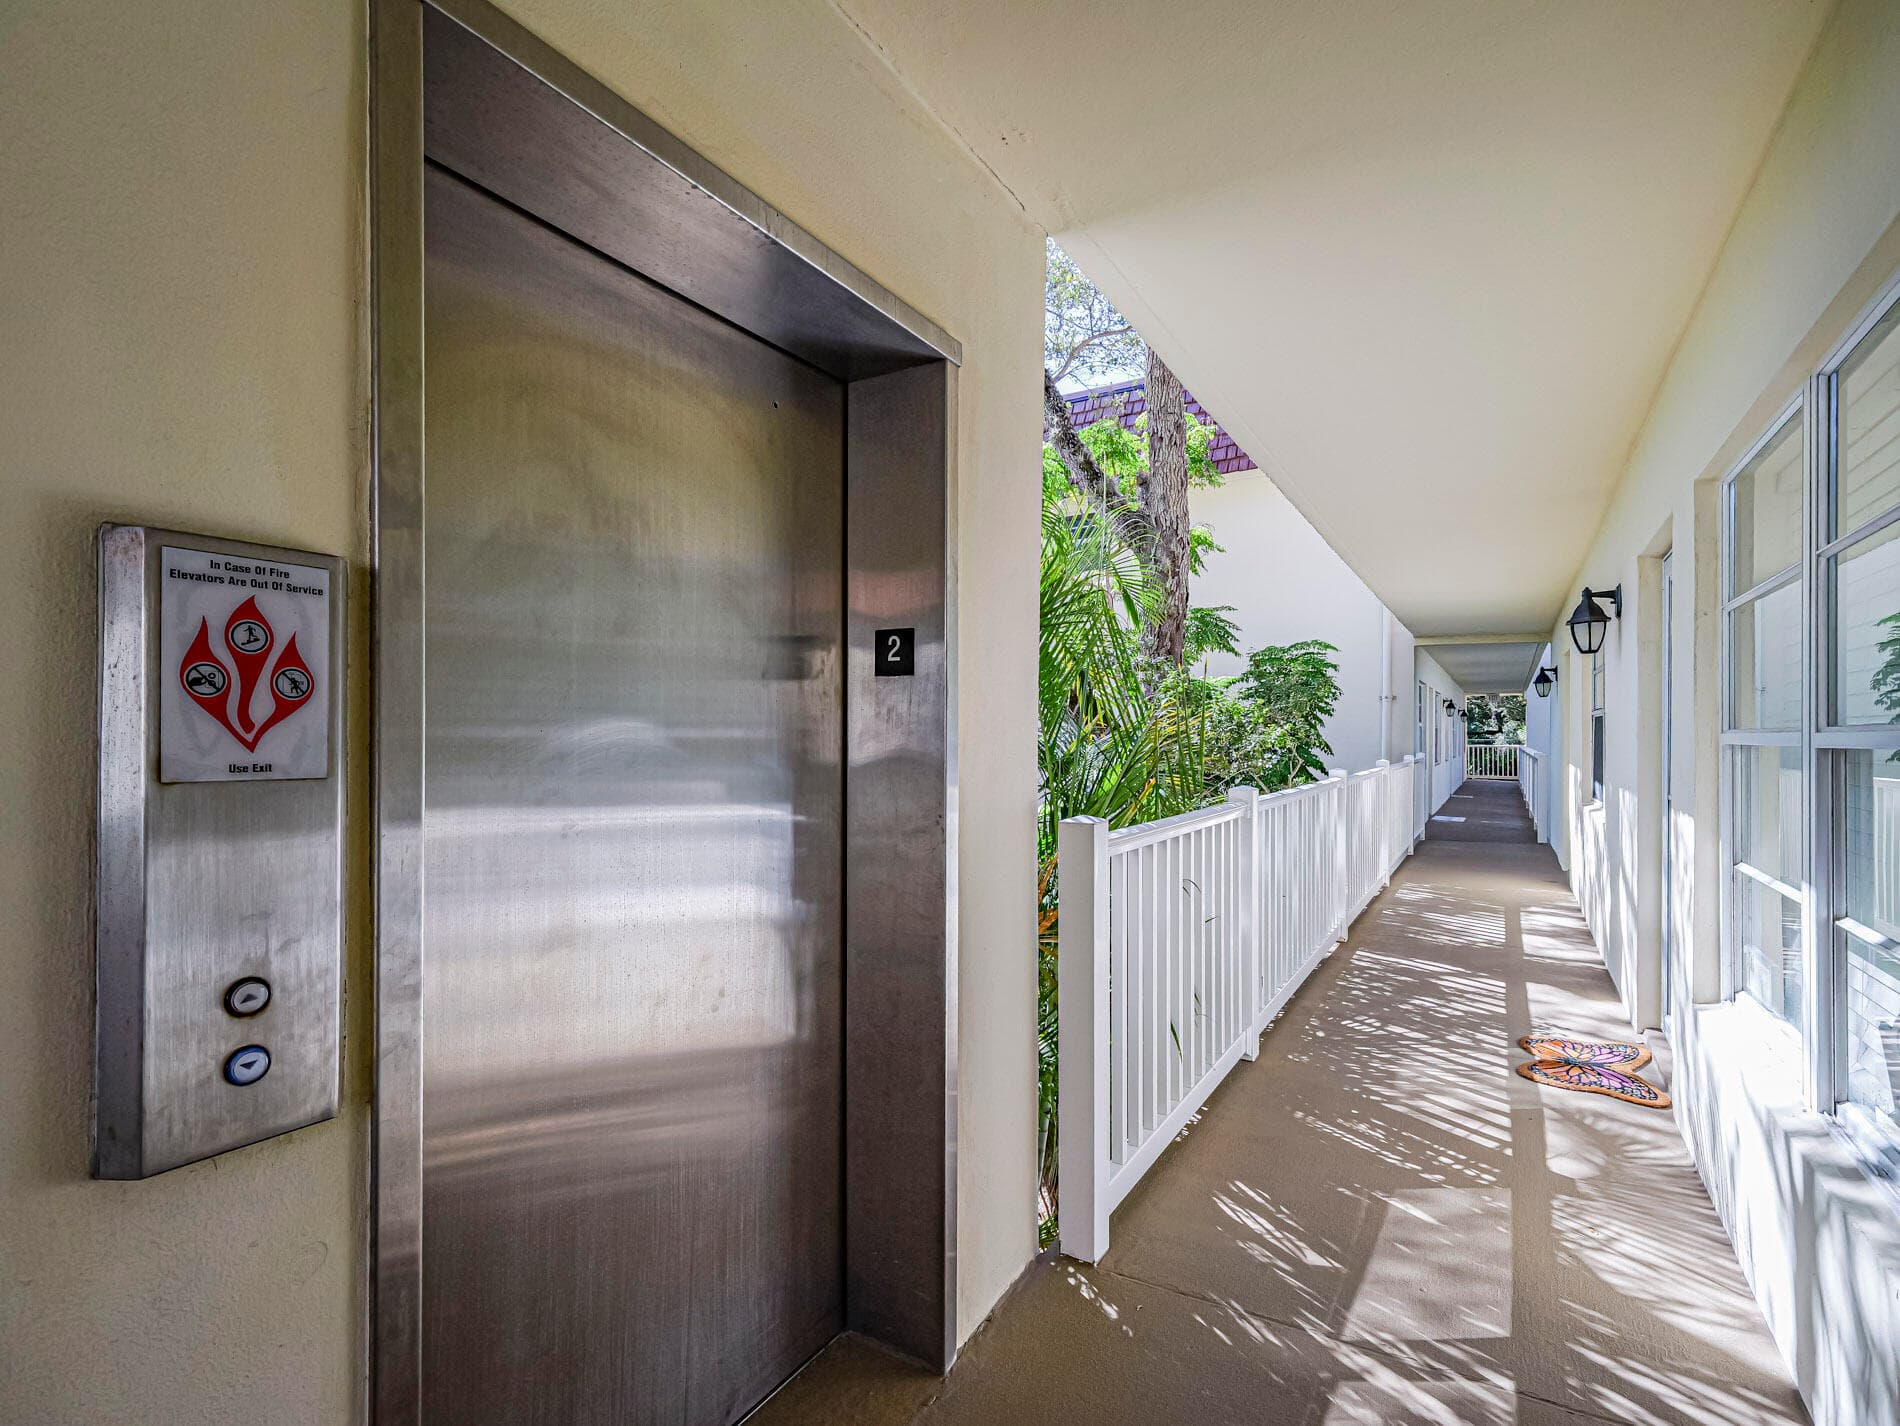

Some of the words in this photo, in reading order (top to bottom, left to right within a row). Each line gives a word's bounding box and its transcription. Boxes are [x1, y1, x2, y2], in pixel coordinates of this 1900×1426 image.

[210, 559, 221, 570] In
[224, 561, 251, 574] Case
[254, 566, 266, 576] Of
[269, 567, 290, 579] Fire
[169, 568, 225, 584] Elevators
[228, 576, 247, 587] Are
[250, 578, 269, 590] Out
[271, 581, 283, 591] Of
[286, 583, 324, 596] Service
[887, 635, 901, 662] 2
[228, 764, 249, 773] Use
[252, 763, 273, 773] Exit
